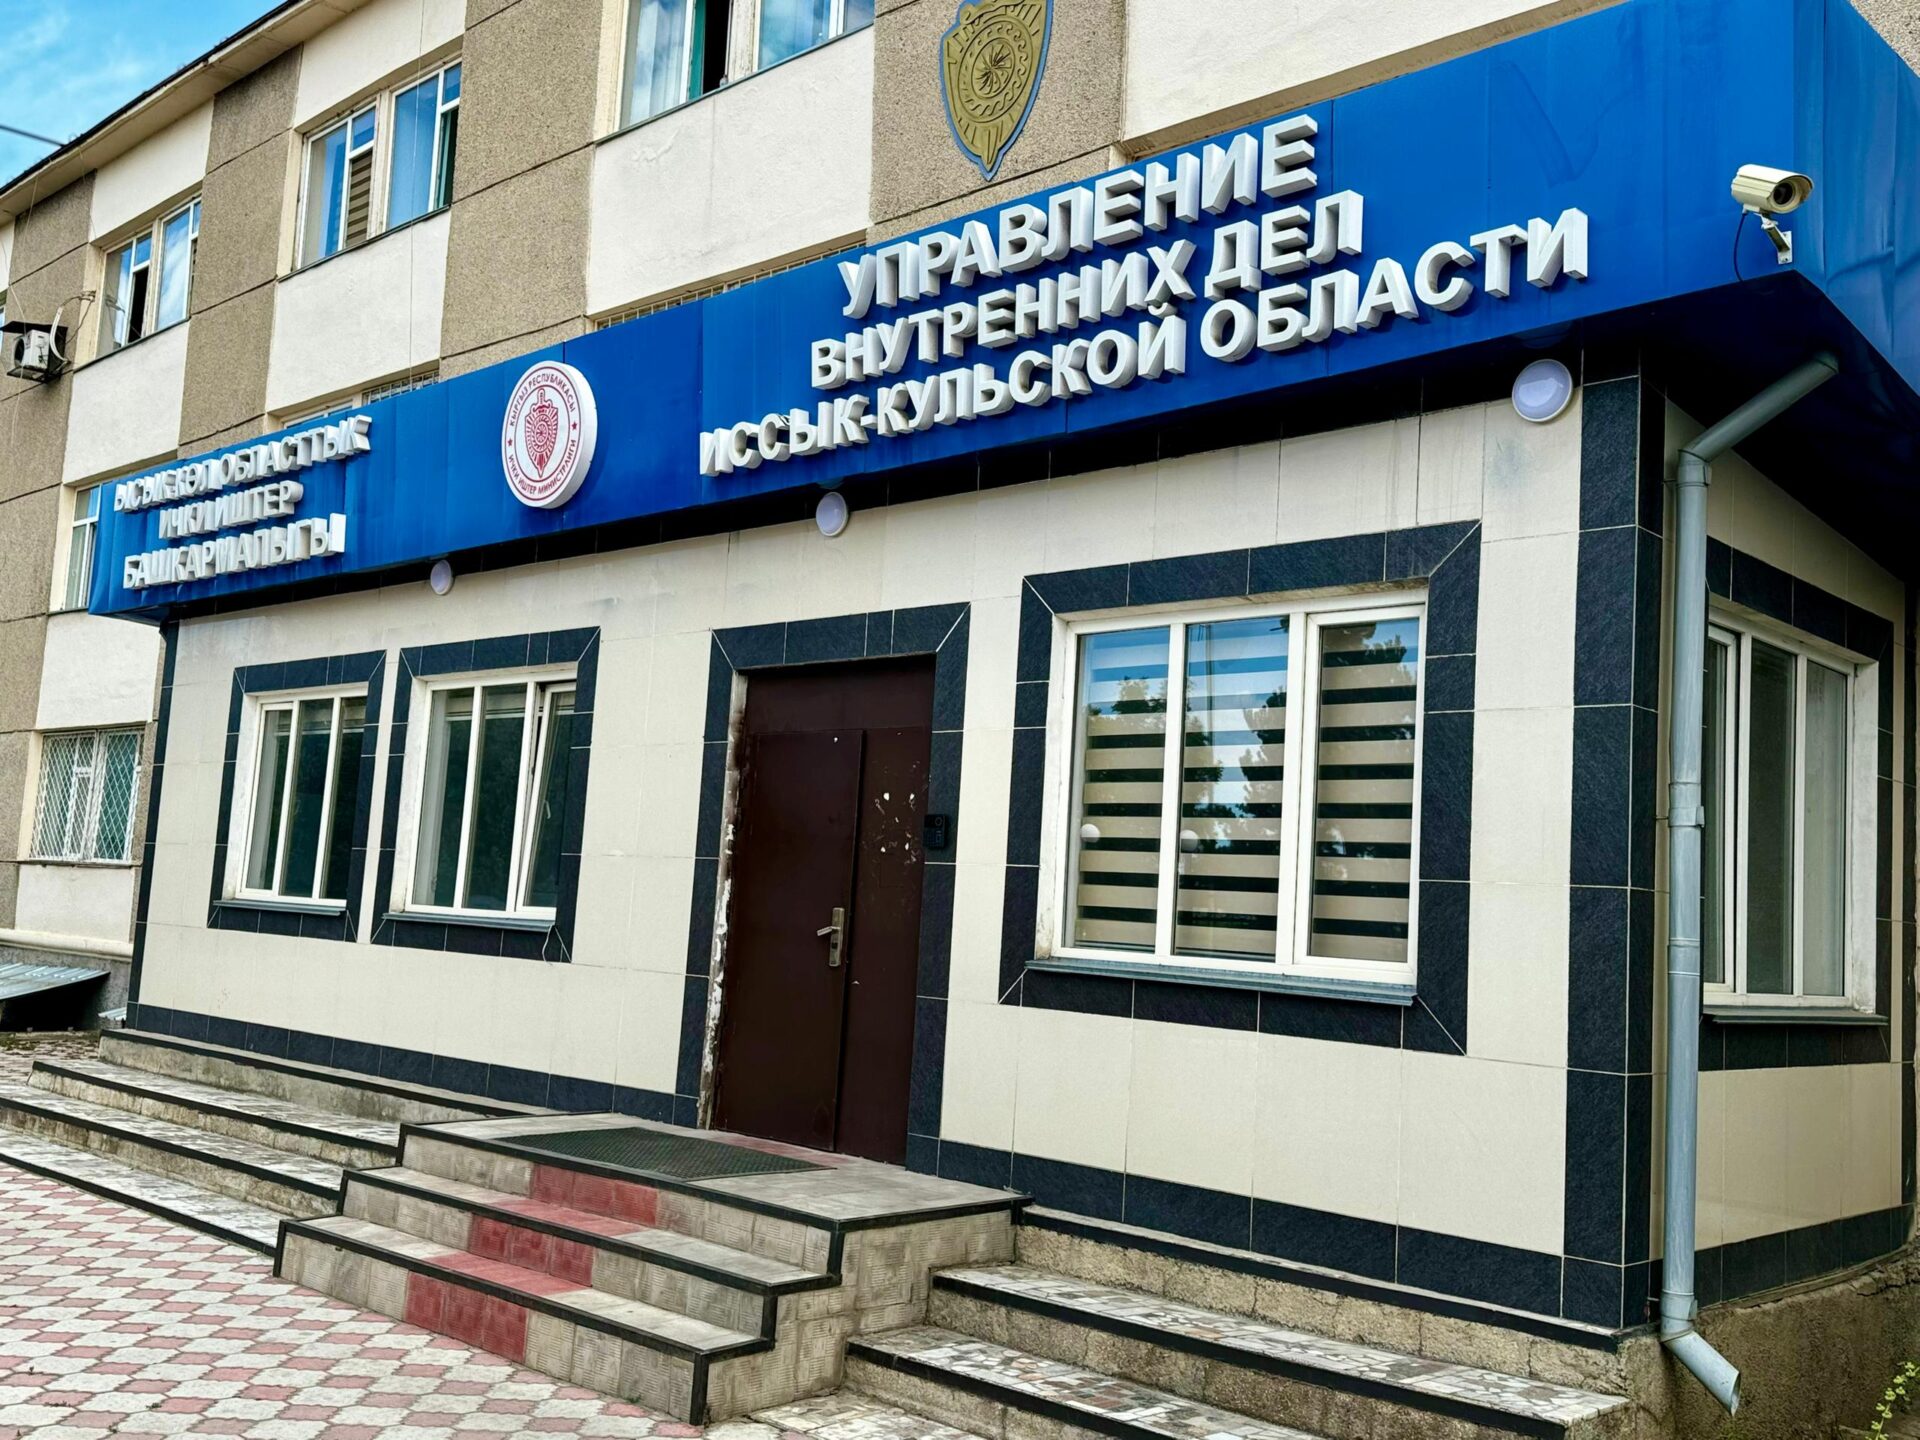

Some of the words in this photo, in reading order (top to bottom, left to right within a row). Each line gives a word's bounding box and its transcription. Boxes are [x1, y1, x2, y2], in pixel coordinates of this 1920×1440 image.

[838, 113, 1318, 318] УПРАВЛЕНИЕ
[811, 239, 1197, 390] ВНУТРЕННИХ
[1204, 189, 1364, 300] ДЕЛ
[700, 303, 1187, 477] ИССЫК-КУЛЬСКОЙ
[1200, 207, 1589, 362] ОБЛАСТИ
[509, 384, 529, 427] КЫРГЫЗ
[528, 372, 576, 413] РЕСПУБЛИКАСЫ
[508, 454, 520, 480] ИЧКИ
[518, 476, 537, 495] ИШТЕР
[537, 439, 577, 494] МИНИСТРЛИГИ
[159, 500, 218, 539] ИЧКИ
[214, 480, 304, 528] ИШТЕР
[123, 512, 347, 590] БАШКАРМАЛЫГЫ
